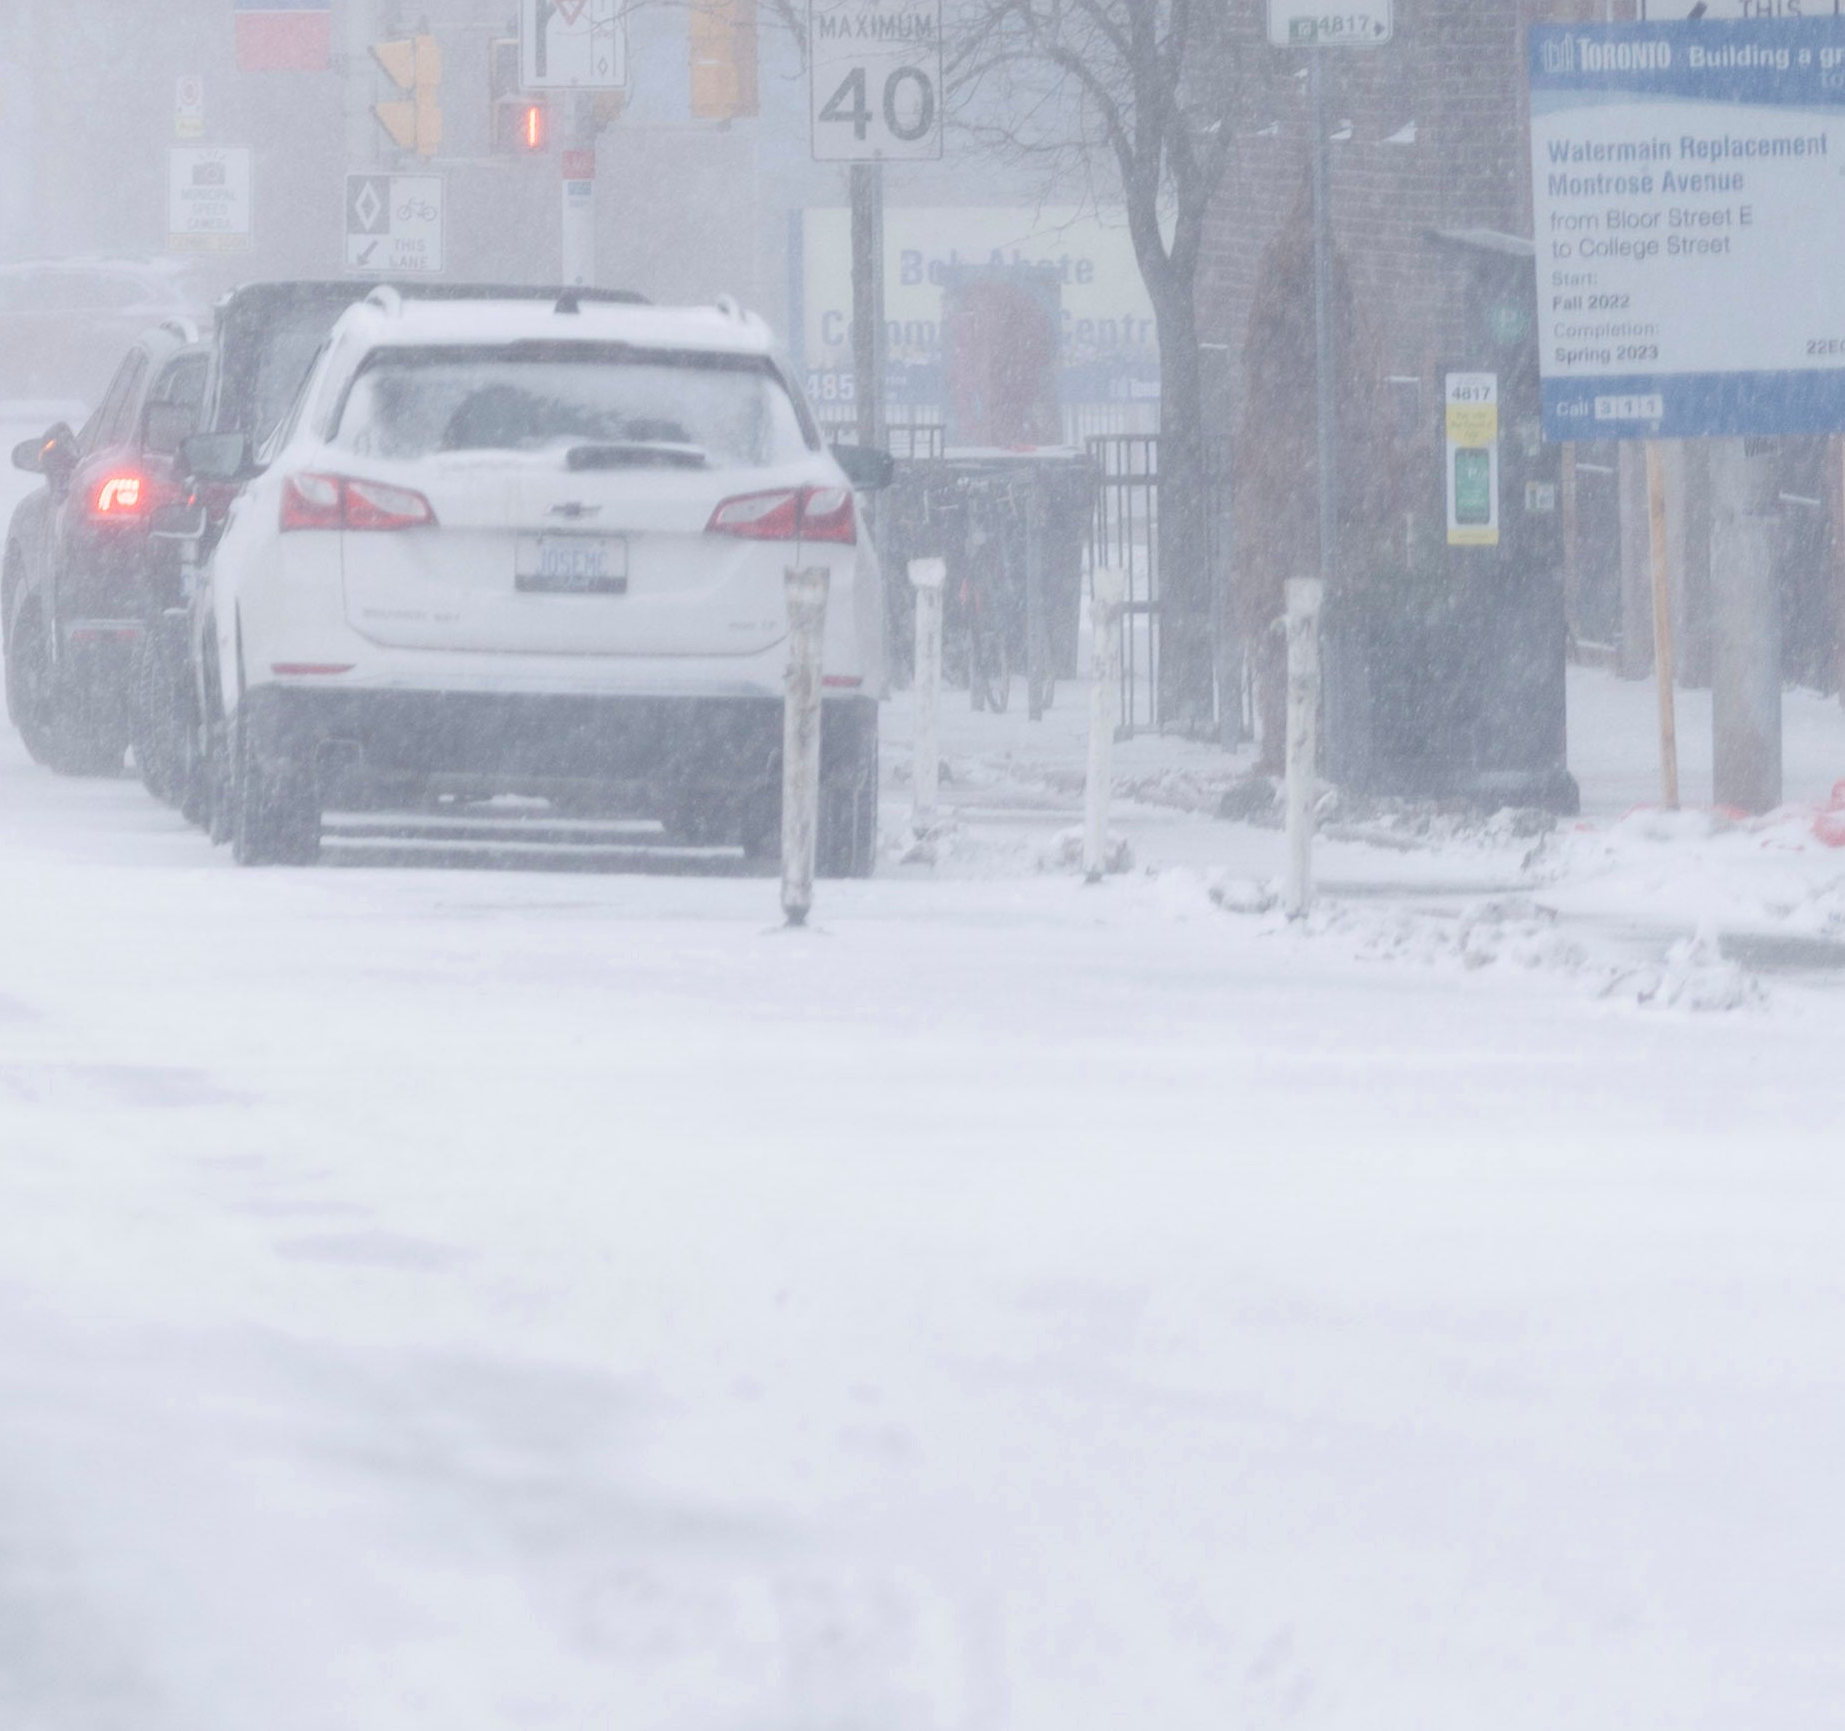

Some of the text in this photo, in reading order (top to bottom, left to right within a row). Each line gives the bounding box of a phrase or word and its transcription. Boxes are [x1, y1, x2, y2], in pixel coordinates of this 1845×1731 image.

[819, 13, 933, 39] MAXIMUM
[1317, 14, 1370, 33] 4817
[1577, 37, 1845, 70] TORONTO Building a gr
[1820, 69, 1845, 89] to
[818, 66, 935, 141] 40
[1548, 132, 1829, 163] Watermain Replacement
[1547, 169, 1744, 196] Montrose Avenue
[1551, 206, 1753, 231] from Bloor Street E
[393, 238, 427, 253] THIS
[1552, 235, 1731, 261] to College Street
[390, 255, 429, 269] LANE
[1551, 270, 1598, 288] Start:
[1552, 294, 1631, 311] Fall 2022
[1553, 321, 1660, 341] Completion:
[1554, 345, 1659, 366] Spring 2023
[1451, 386, 1491, 401] 4817
[1556, 399, 1589, 416] Call
